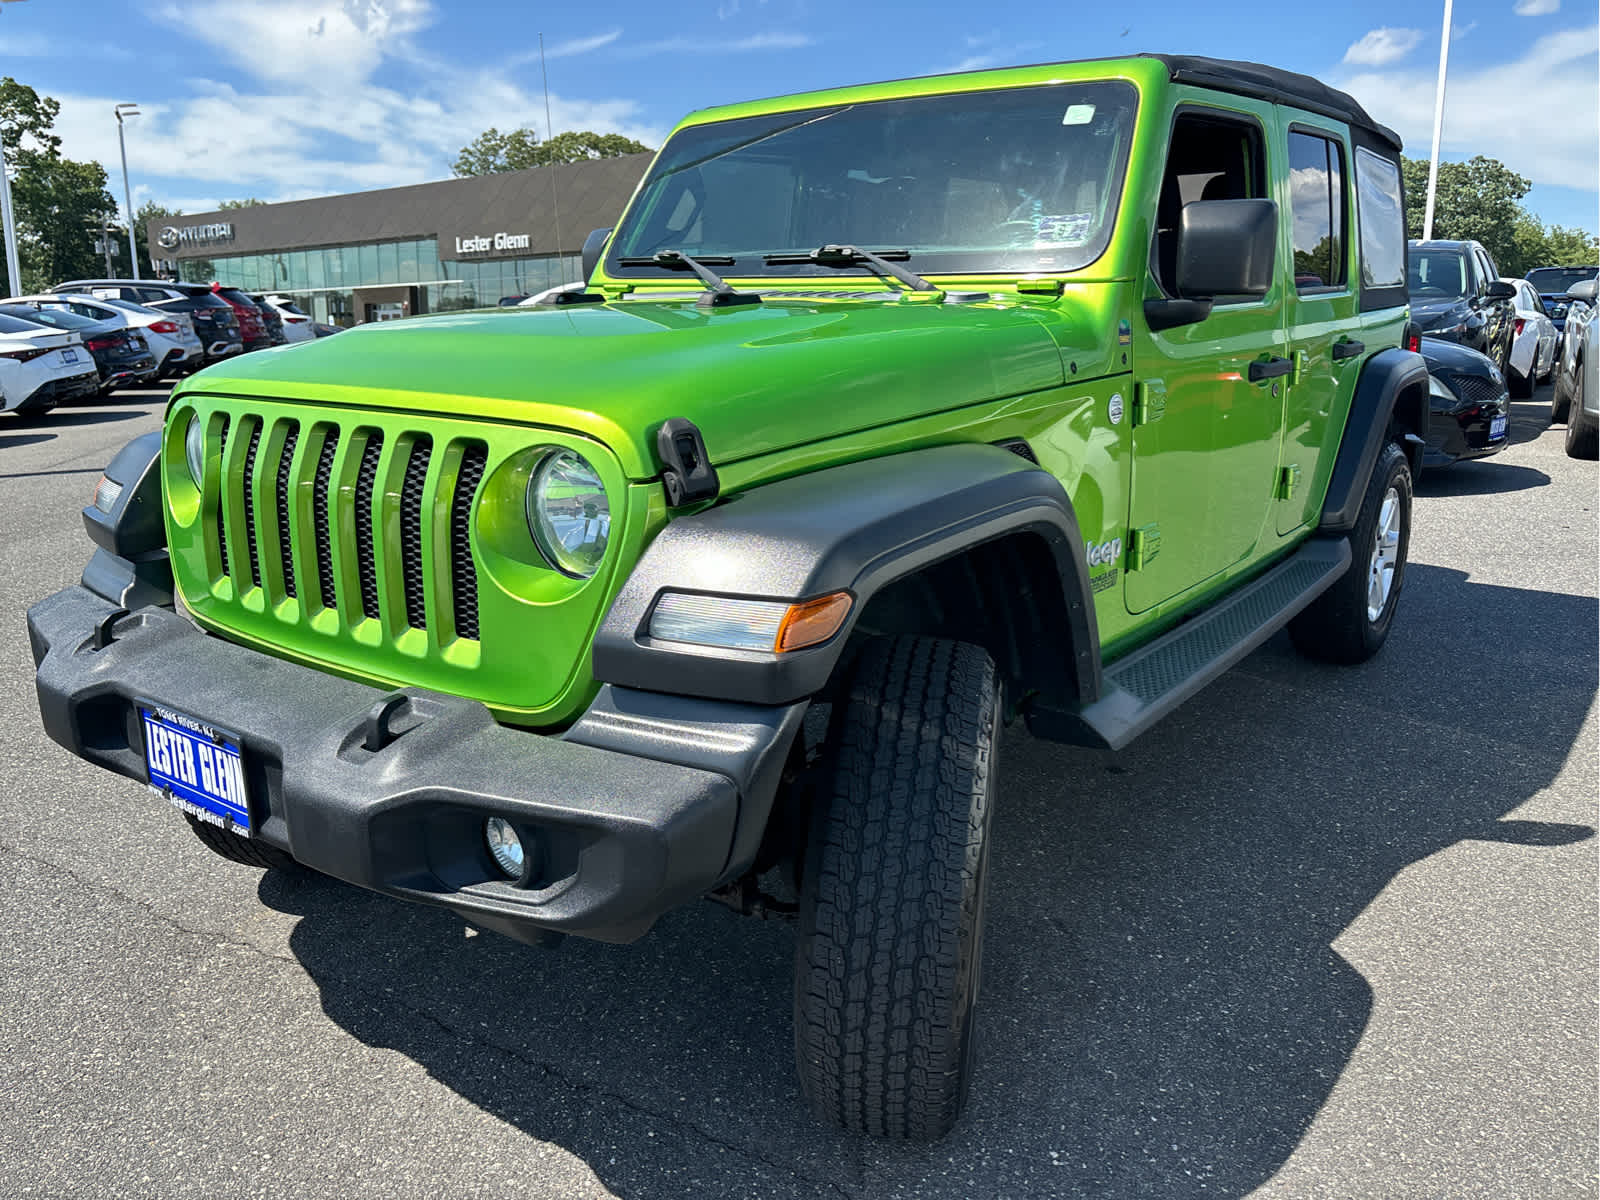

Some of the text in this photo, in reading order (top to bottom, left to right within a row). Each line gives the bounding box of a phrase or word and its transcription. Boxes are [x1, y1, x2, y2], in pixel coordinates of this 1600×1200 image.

[179, 223, 232, 241] HYUNDAI
[456, 232, 529, 253] Lester Glenn
[145, 721, 248, 809] LESTER GLENN
